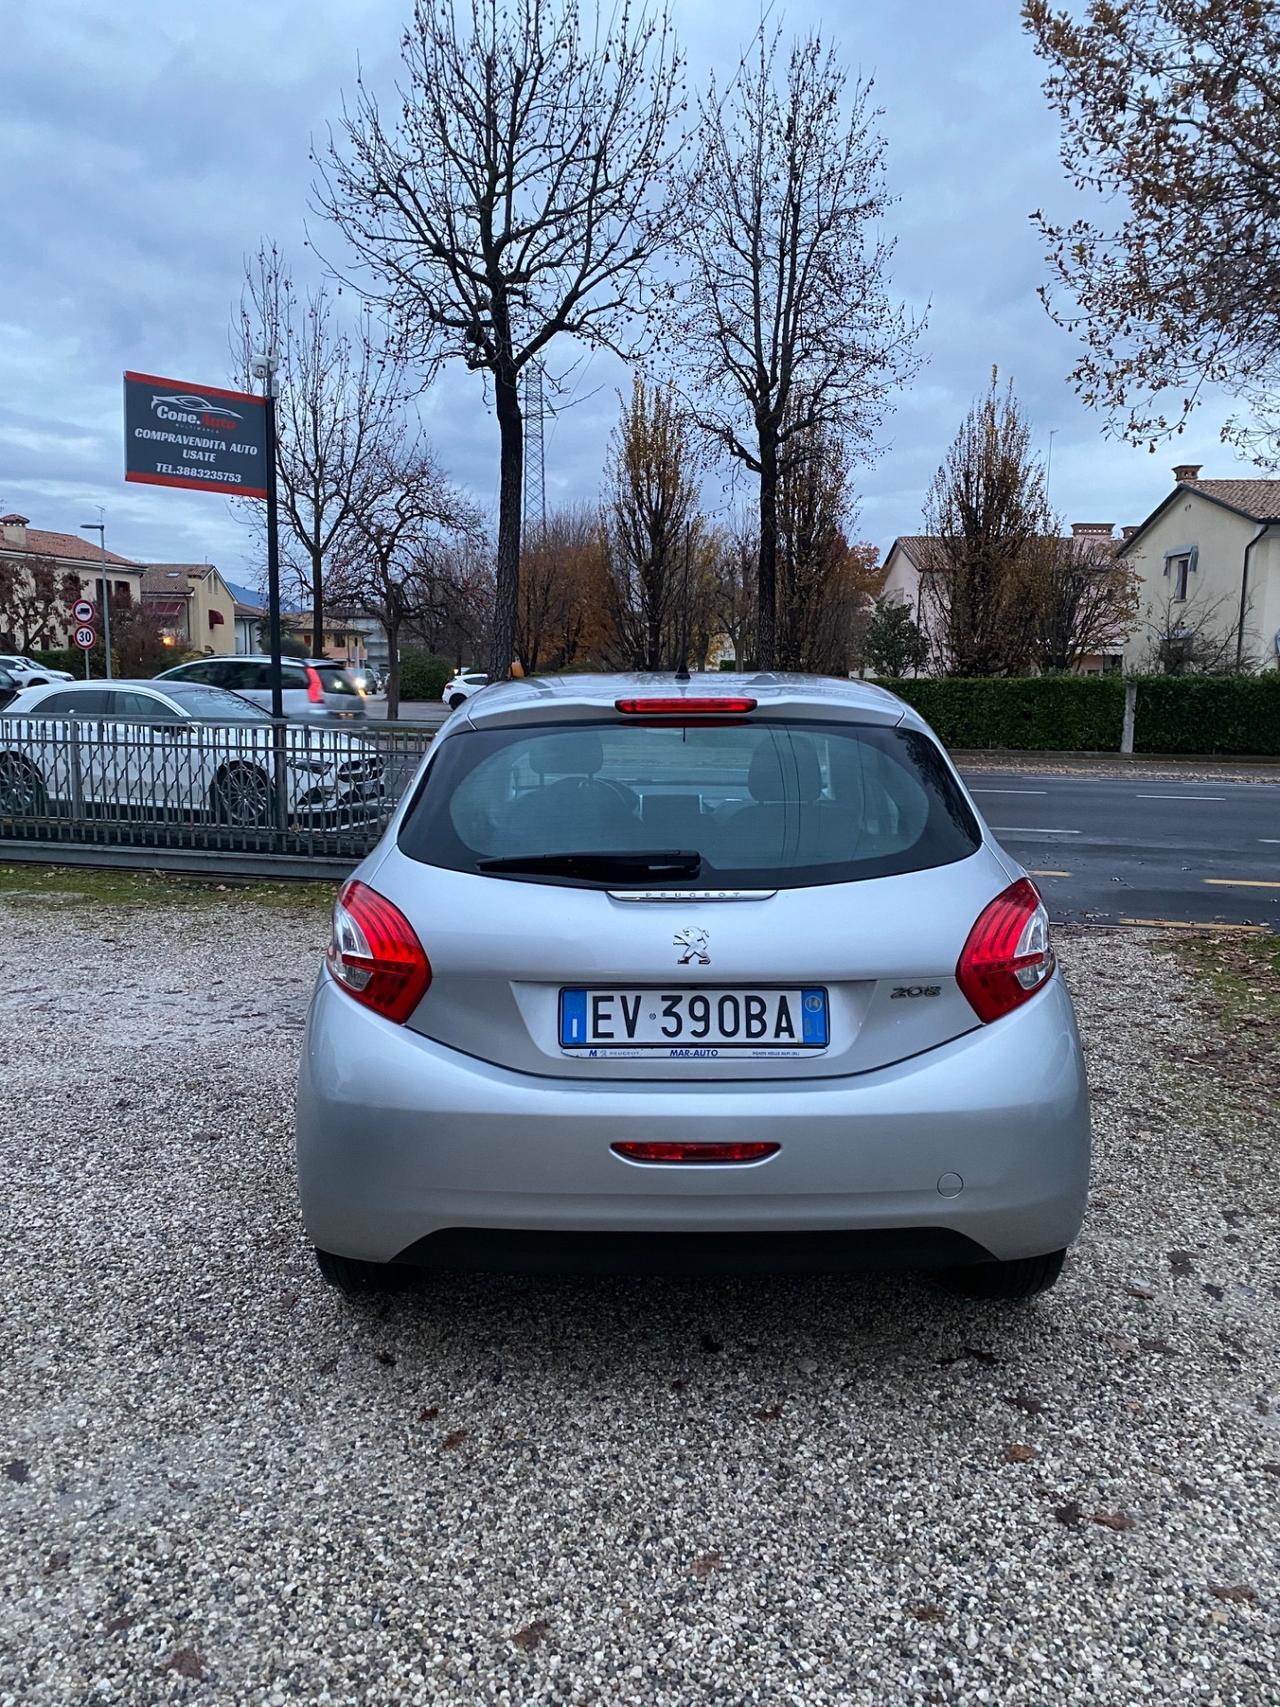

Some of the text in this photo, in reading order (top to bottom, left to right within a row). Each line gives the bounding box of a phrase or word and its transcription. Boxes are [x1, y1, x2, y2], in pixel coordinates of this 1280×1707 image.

[134, 428, 258, 456] COMPRAVENDITA AUTO
[182, 449, 217, 463] USATE
[155, 462, 242, 483] TEL.3883235753
[79, 631, 91, 642] 30
[890, 986, 942, 999] 208
[592, 994, 796, 1039] EV 390BA
[669, 1049, 719, 1057] MAR-AUTO
